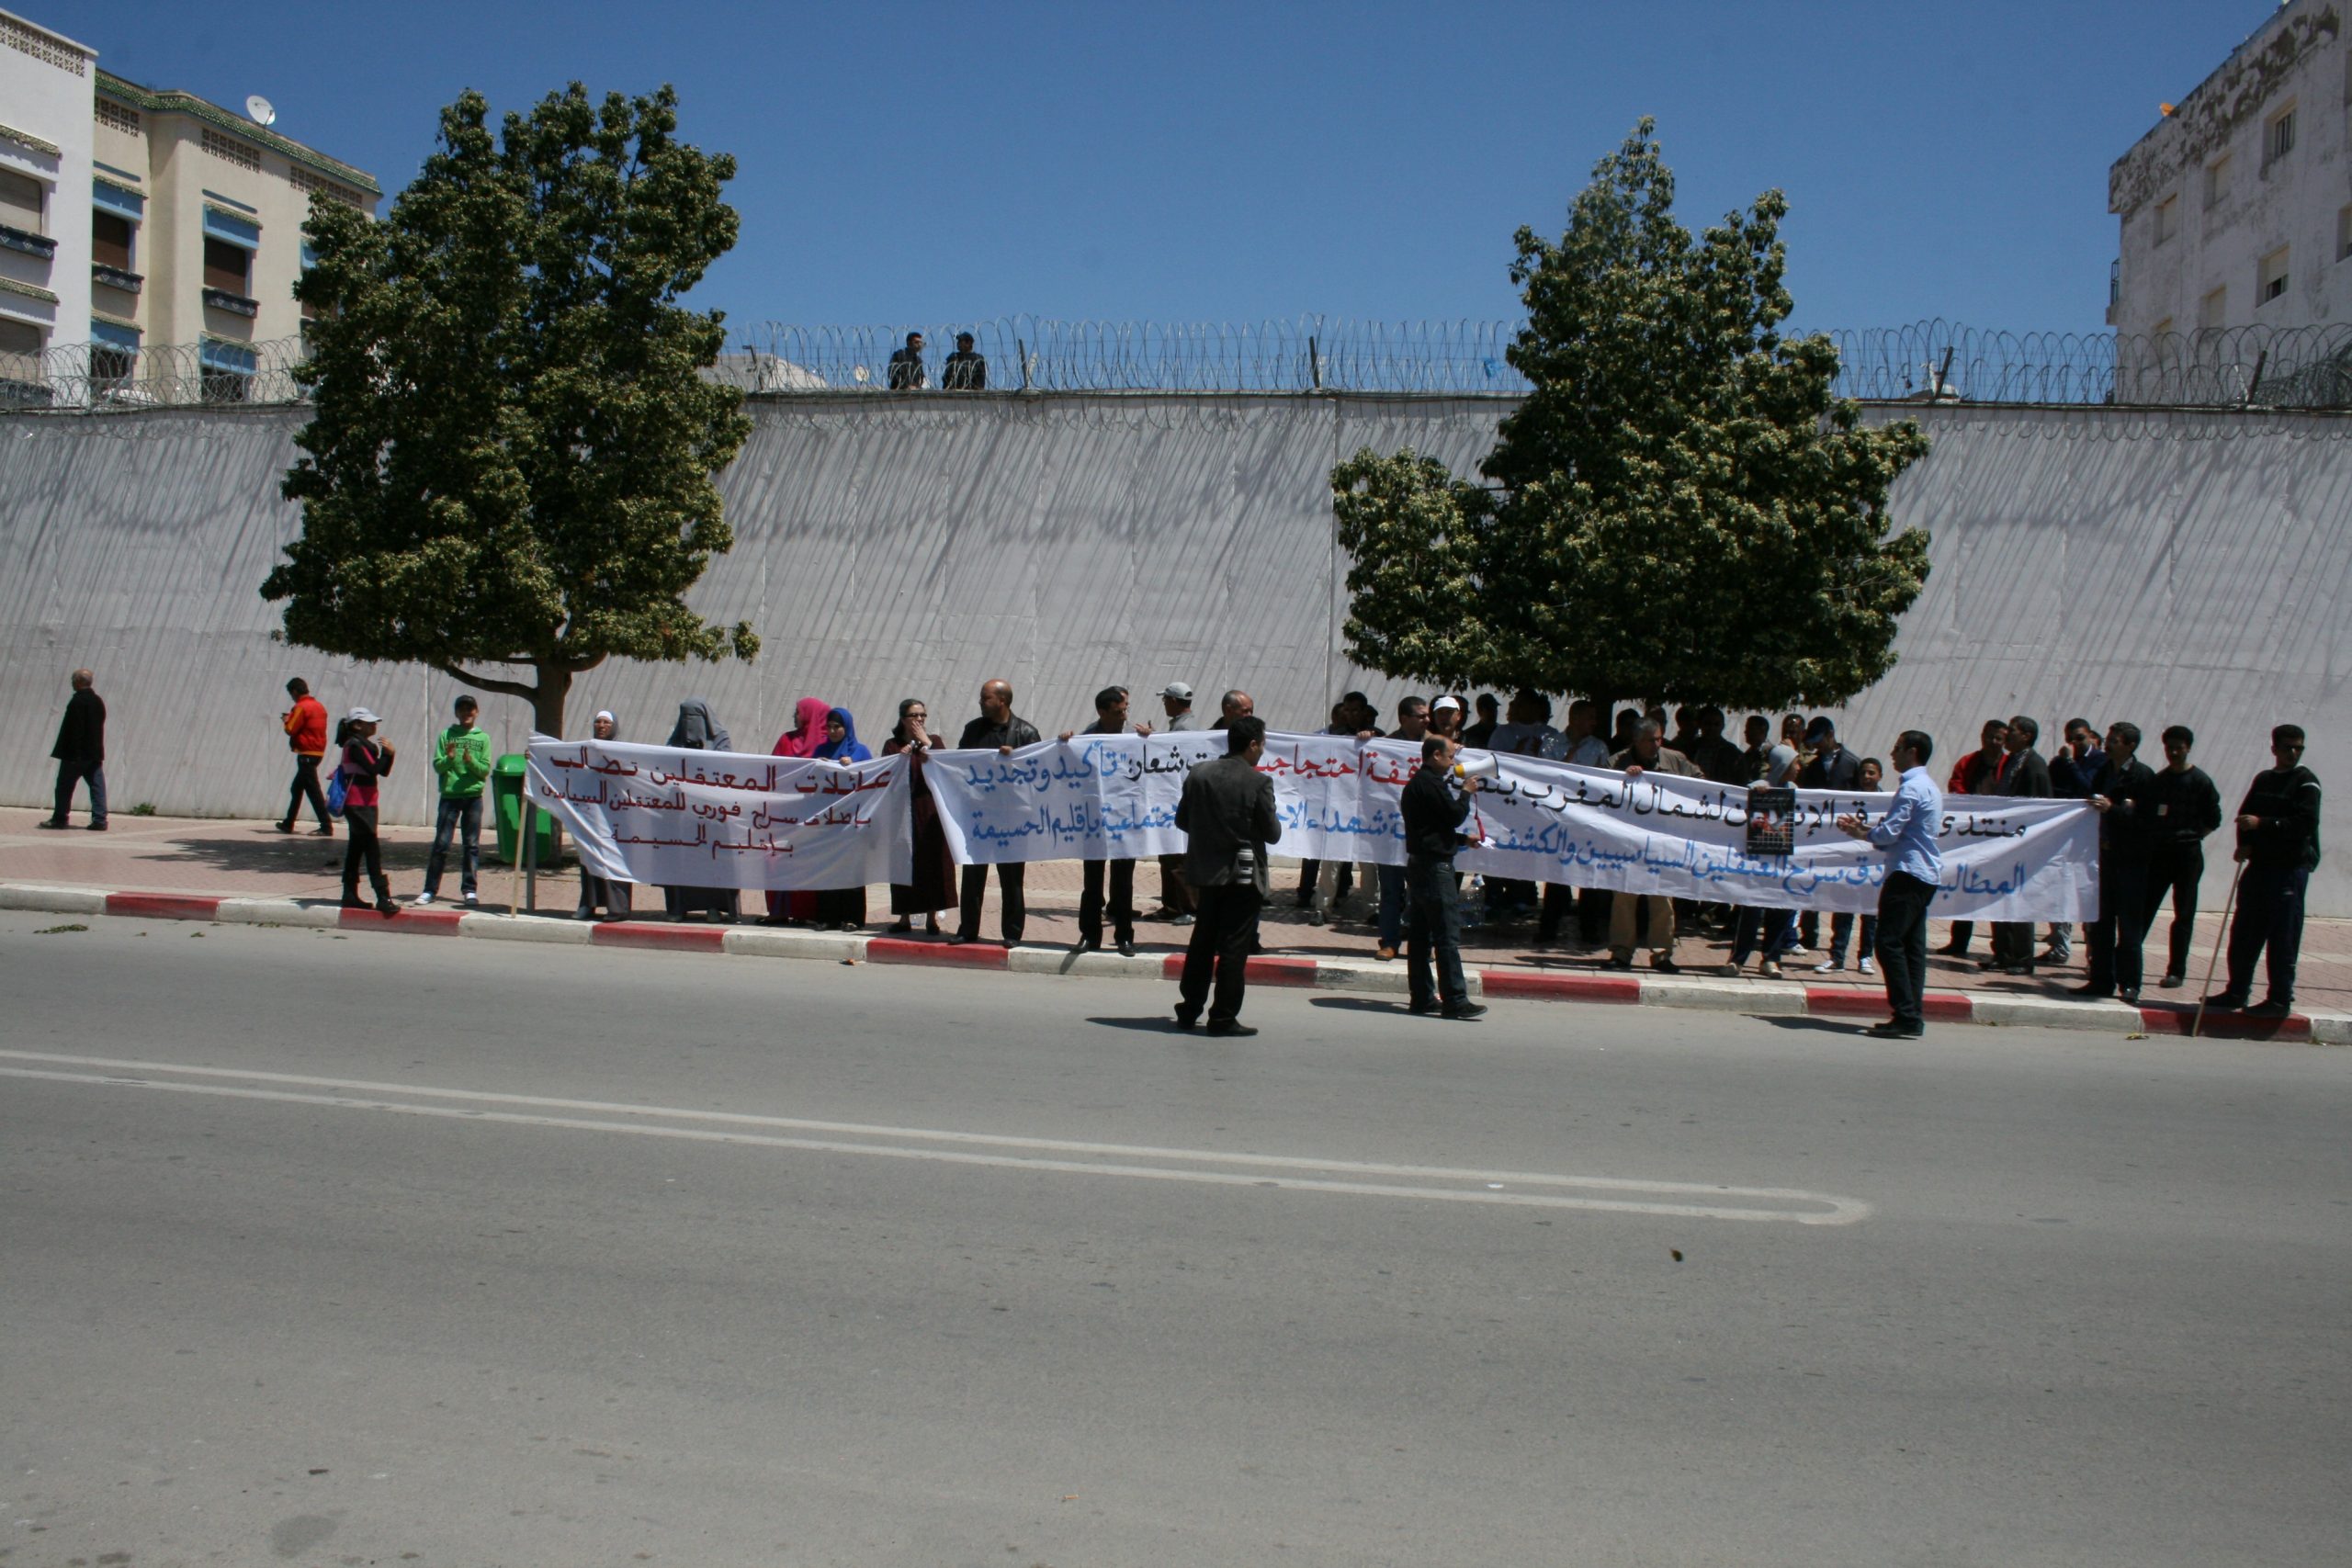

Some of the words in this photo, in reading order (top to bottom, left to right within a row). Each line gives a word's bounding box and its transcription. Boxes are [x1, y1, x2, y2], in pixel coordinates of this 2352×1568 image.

[549, 745, 639, 776] تطالب
[650, 758, 776, 792] المعتقلين
[1253, 743, 1363, 781] احتجاج
[1365, 751, 1421, 785] قفة
[795, 770, 891, 795] عائلات
[1521, 780, 1634, 813] المغرب
[609, 789, 686, 811] للمعتقلين
[692, 801, 742, 823] فوري
[752, 801, 798, 829] سراح
[972, 803, 1051, 847] الحسيمة
[1102, 800, 1177, 840] جتماعية
[1724, 797, 1836, 838] الإنن
[1939, 815, 2027, 838] منتدى
[611, 823, 707, 849] الحسيمة
[711, 828, 794, 860] بإقليم
[1937, 861, 2026, 900] المطالب
